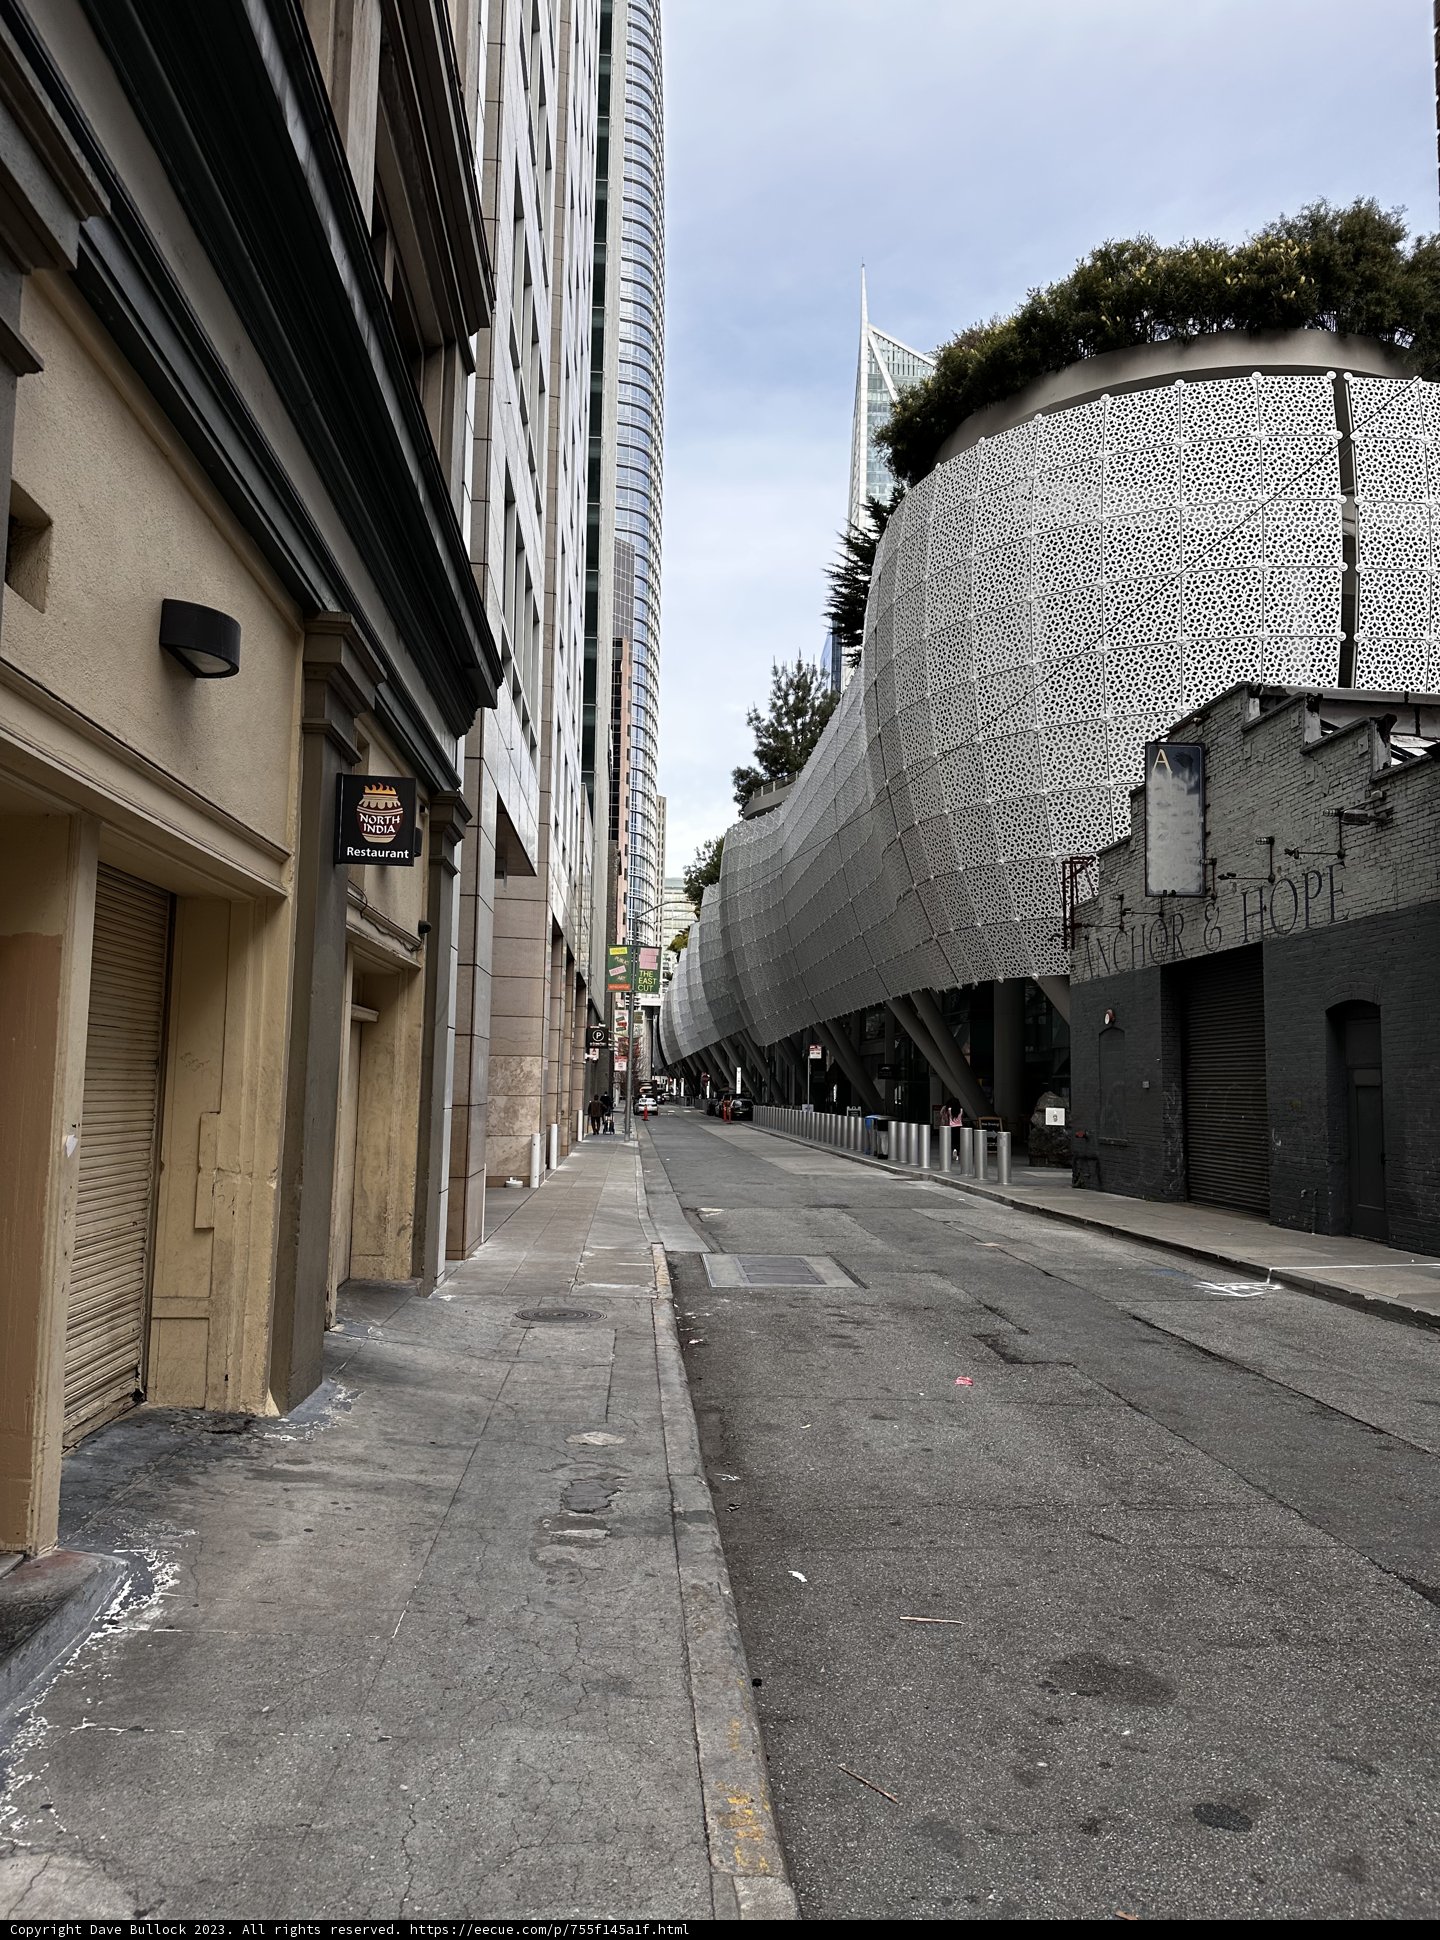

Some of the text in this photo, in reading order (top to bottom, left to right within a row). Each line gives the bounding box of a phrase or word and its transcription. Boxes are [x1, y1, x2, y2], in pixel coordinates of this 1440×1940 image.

[1152, 749, 1173, 773] A
[359, 813, 400, 825] NORTH
[363, 823, 395, 834] INDIA
[346, 846, 409, 859] Restaurant
[1203, 902, 1223, 952] &
[1240, 860, 1350, 944] HOPE
[638, 977, 657, 985] EAST
[637, 984, 654, 992] CUT
